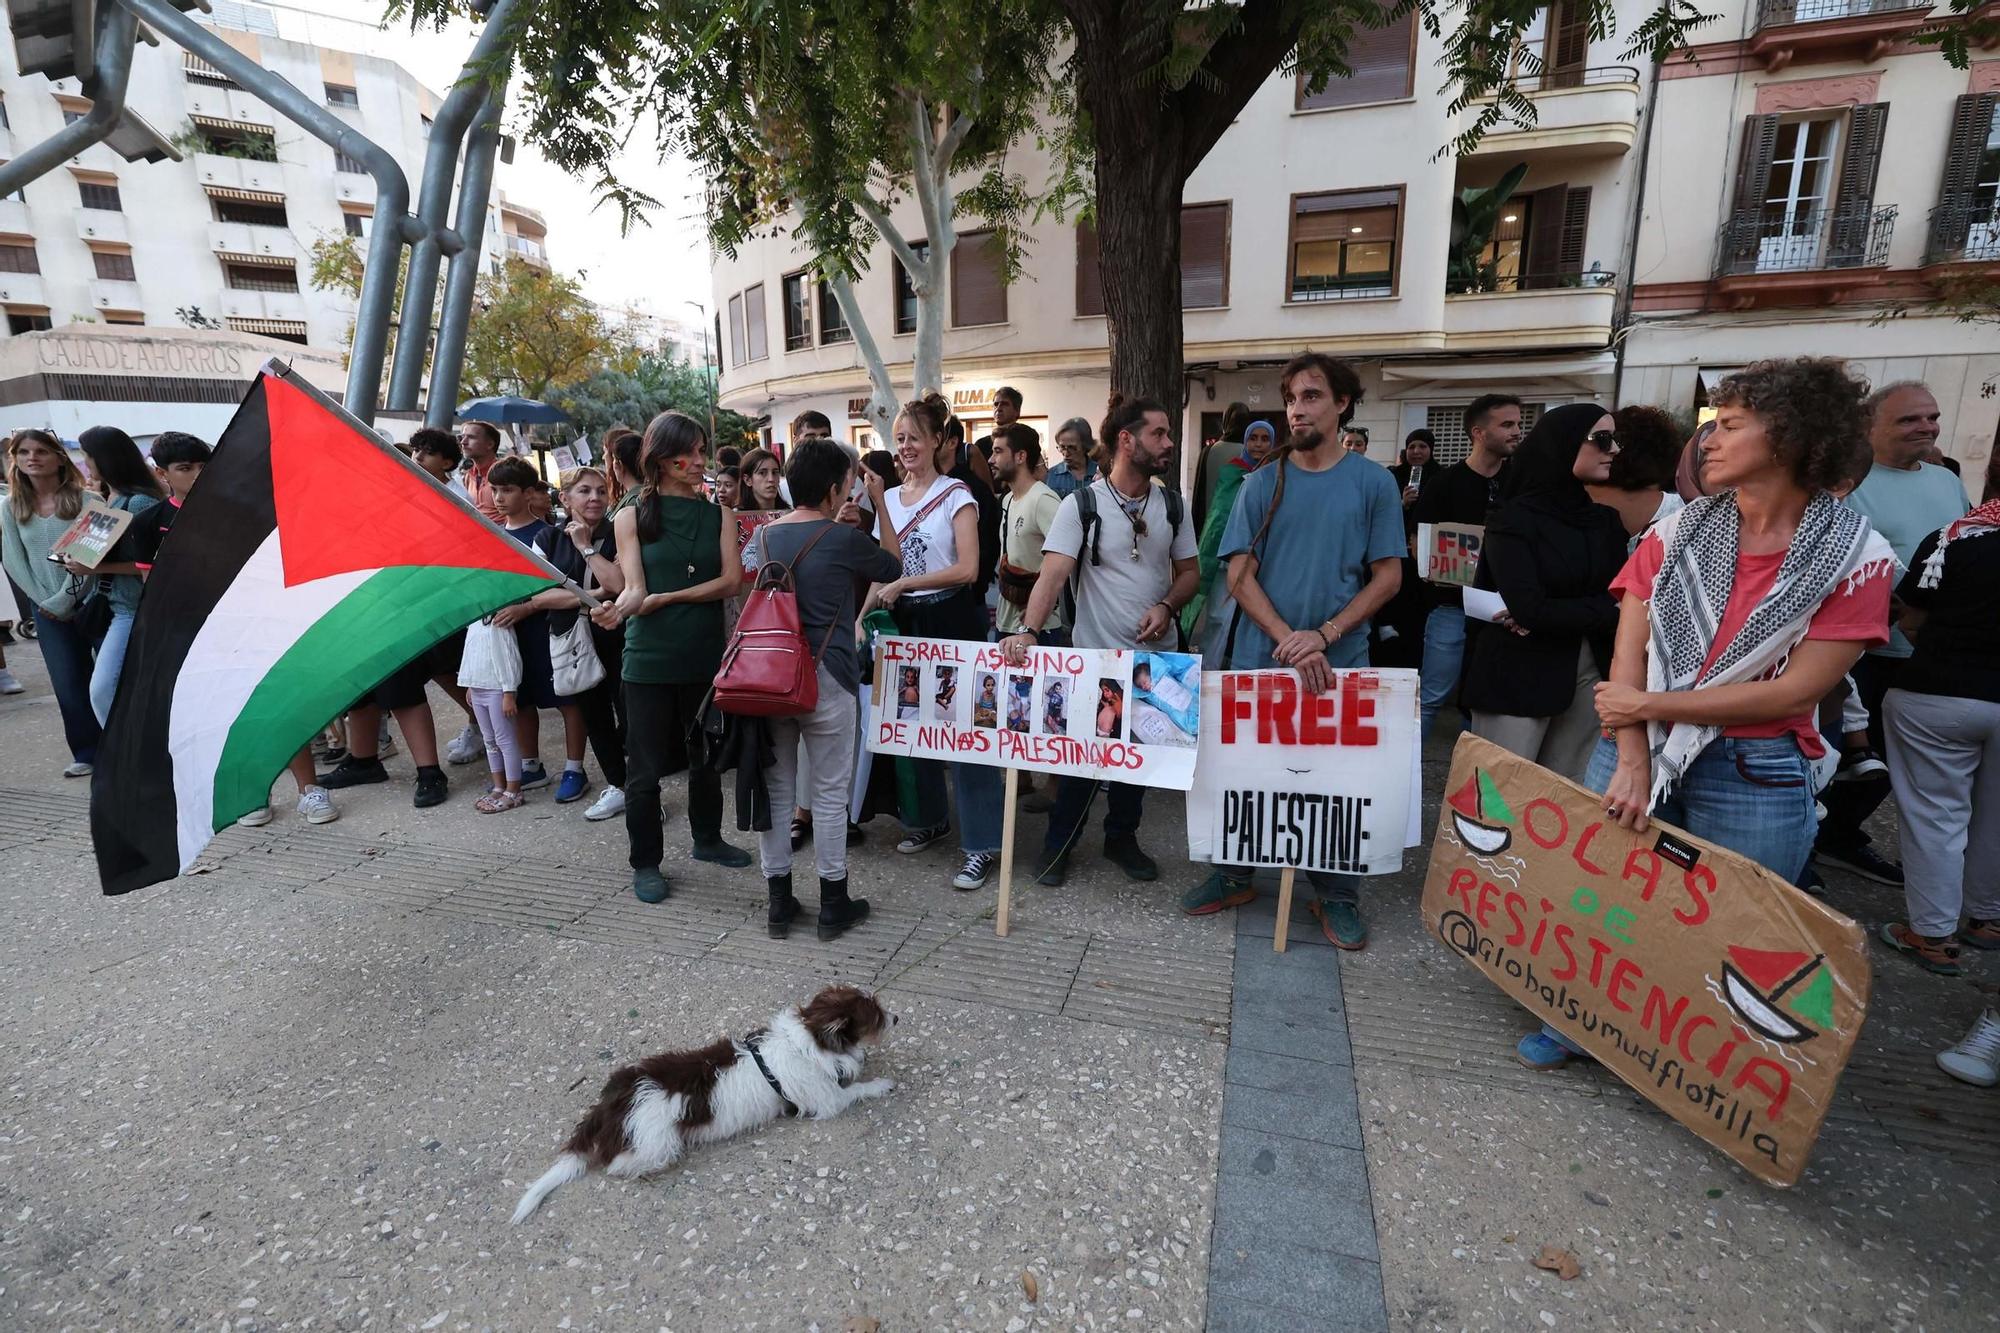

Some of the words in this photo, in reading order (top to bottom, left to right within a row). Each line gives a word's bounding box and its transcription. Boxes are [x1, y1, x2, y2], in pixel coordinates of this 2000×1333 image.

[37, 338, 100, 368] CAJA
[103, 340, 134, 370] DE
[136, 342, 241, 374] AHORROS
[884, 640, 966, 663] ISRAEL
[880, 722, 908, 745] DE
[1221, 671, 1379, 746] FREE
[1222, 789, 1372, 874] PALESTINE
[1523, 797, 1717, 926] OLAS
[1569, 885, 1638, 945] DE
